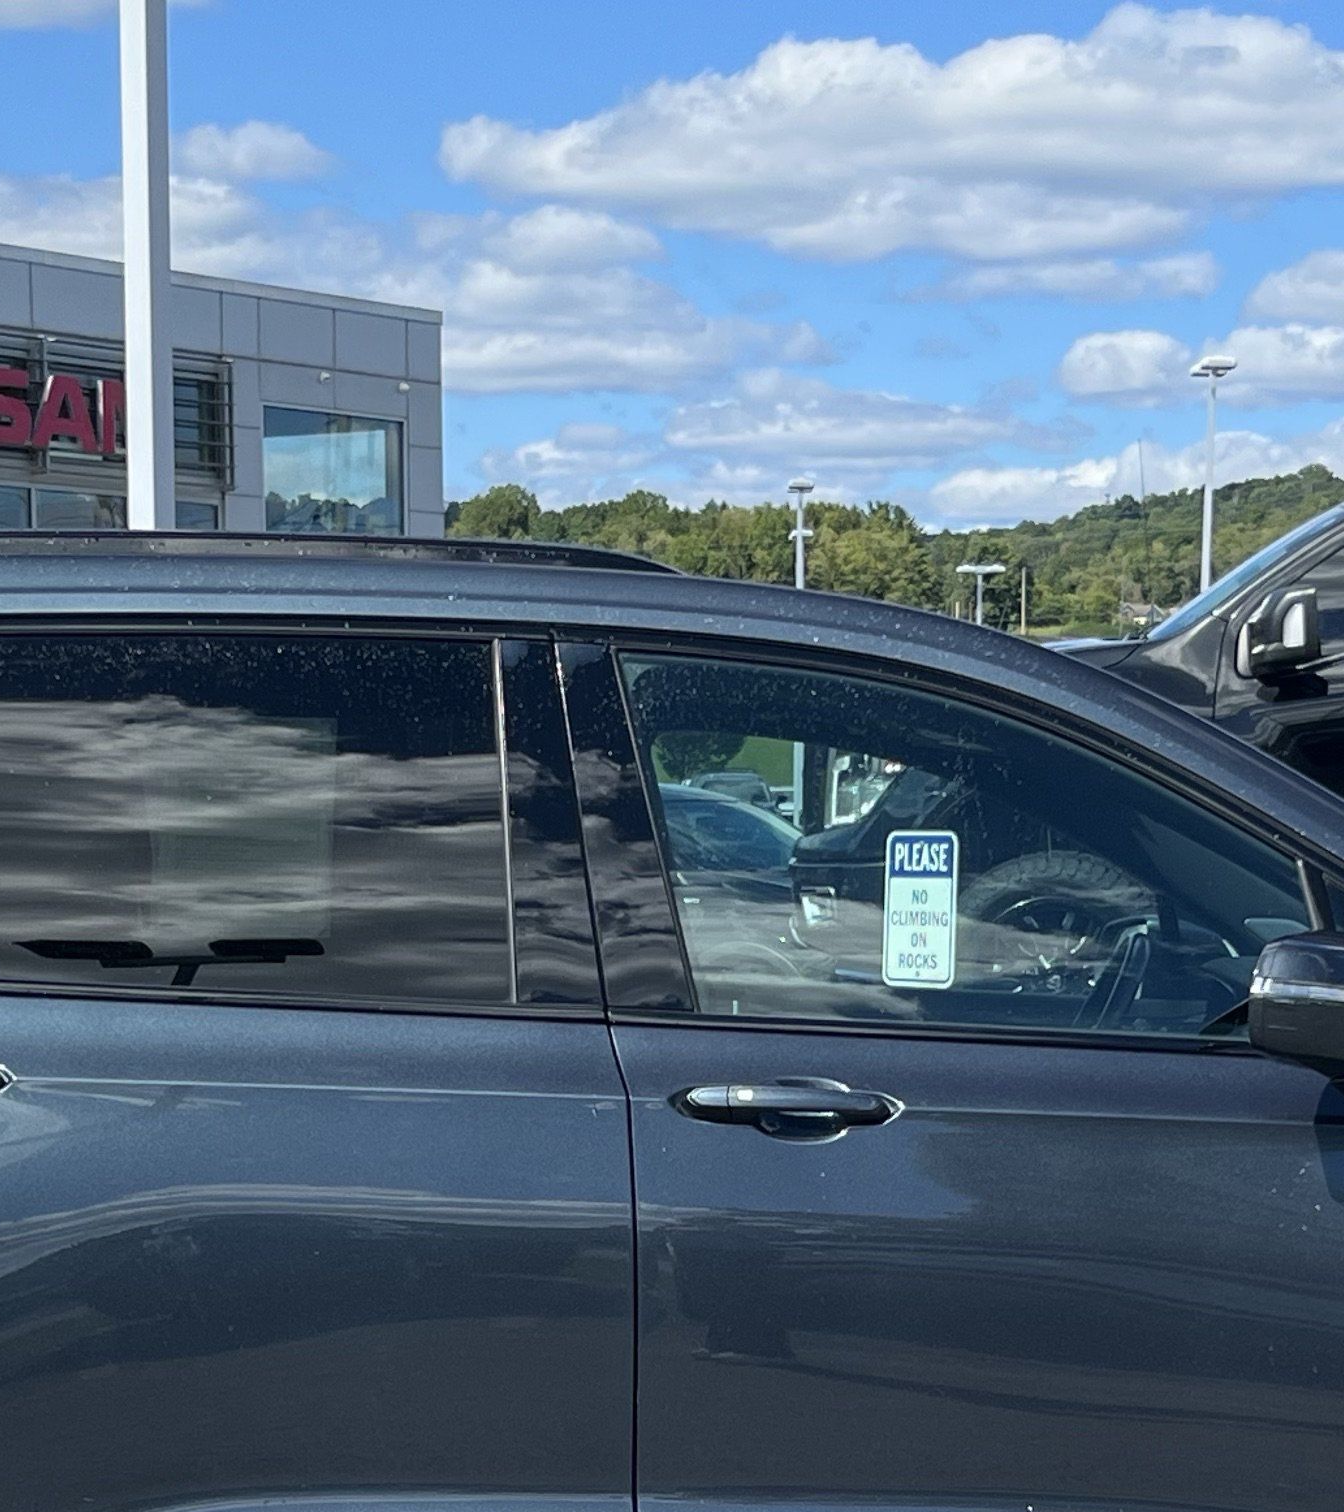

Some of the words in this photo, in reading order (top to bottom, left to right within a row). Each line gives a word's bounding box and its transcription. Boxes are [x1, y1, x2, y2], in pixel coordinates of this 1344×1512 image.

[894, 843, 949, 872] PLEASE
[911, 889, 928, 905] NO
[891, 911, 949, 927] CLIMBING
[910, 933, 927, 948] ON
[898, 954, 938, 970] ROCKS
